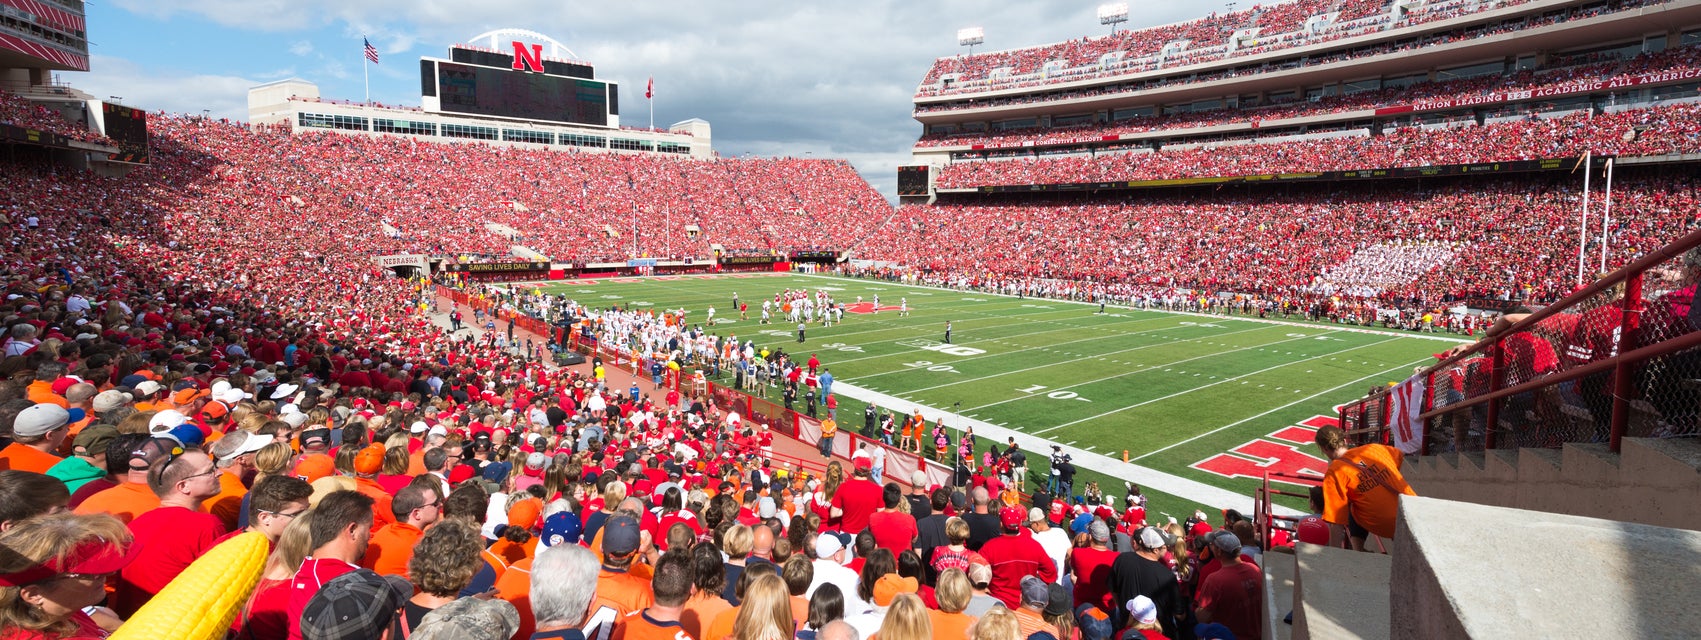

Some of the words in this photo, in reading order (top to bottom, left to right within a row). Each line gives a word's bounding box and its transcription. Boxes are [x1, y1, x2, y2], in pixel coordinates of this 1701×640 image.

[511, 41, 544, 72] N
[1413, 100, 1451, 111] NATION
[1456, 94, 1502, 106] LEADING
[1508, 91, 1531, 100] 325
[1536, 82, 1603, 97] ACADEMIC
[1609, 78, 1633, 88] ALL
[1036, 138, 1074, 146] CONSECUTIVE
[383, 257, 418, 265] NEBRASKA
[1469, 297, 1502, 309] FOLTZ
[1015, 383, 1080, 401] 10
